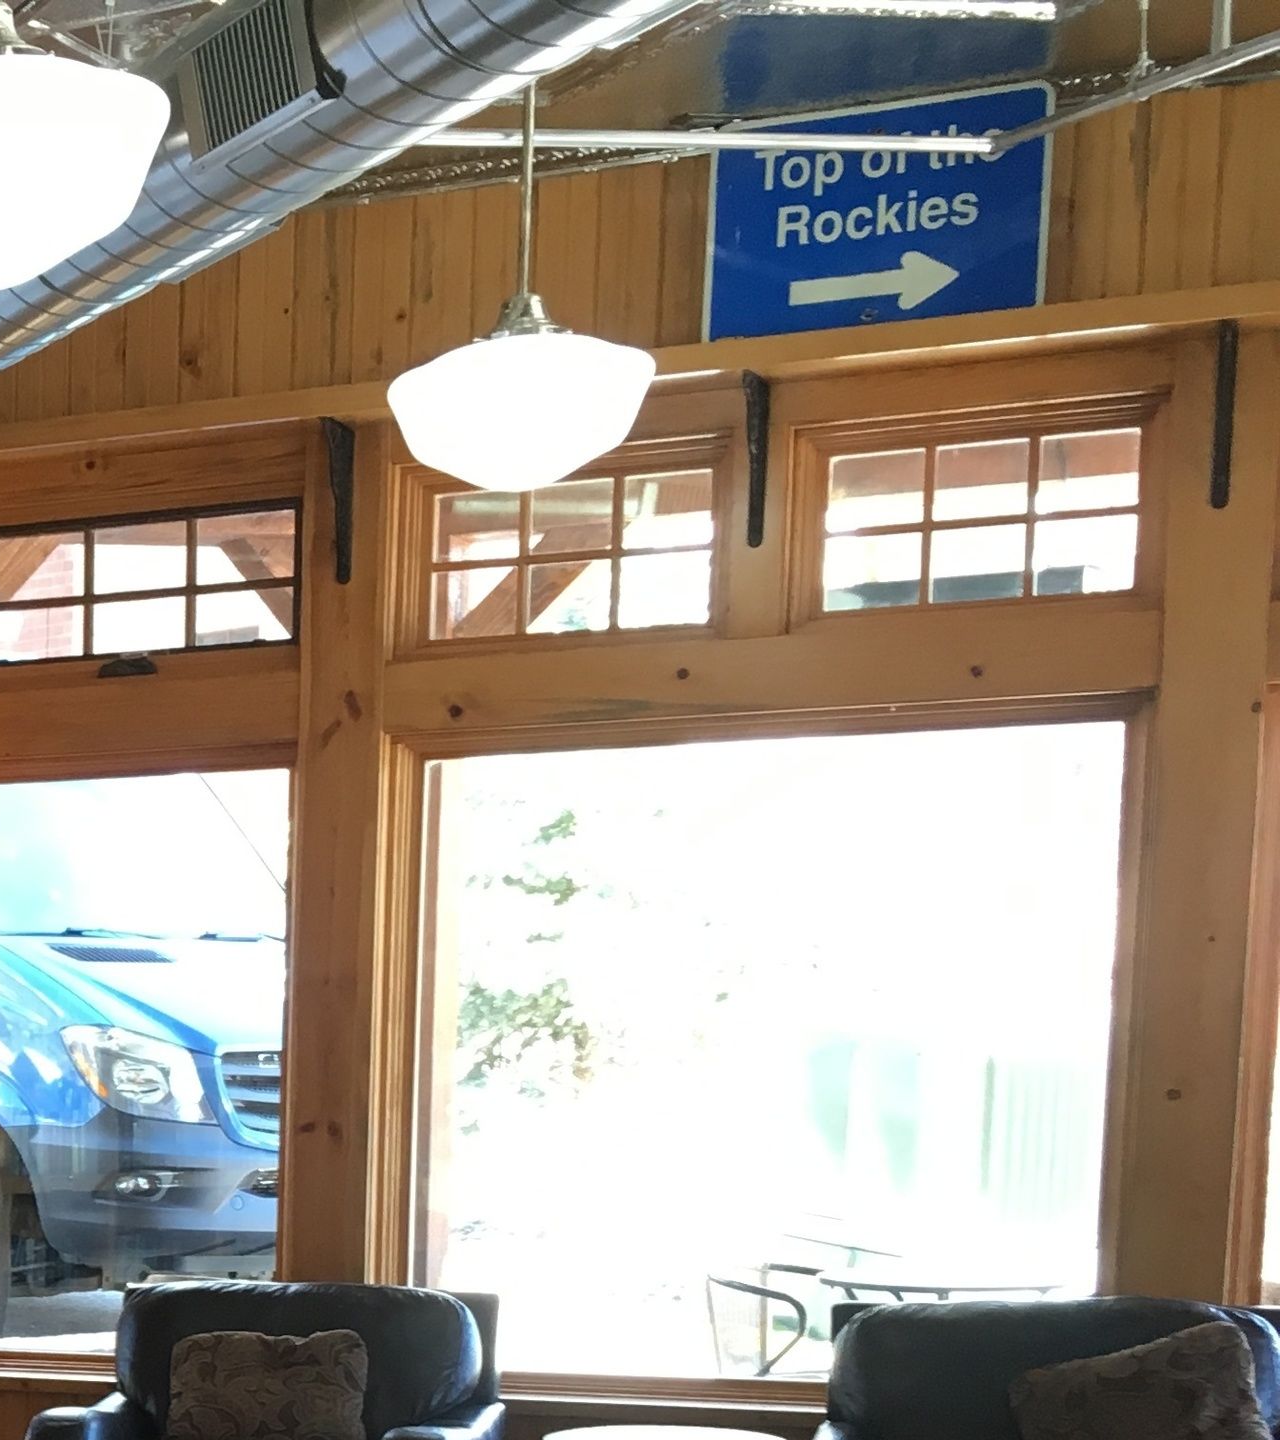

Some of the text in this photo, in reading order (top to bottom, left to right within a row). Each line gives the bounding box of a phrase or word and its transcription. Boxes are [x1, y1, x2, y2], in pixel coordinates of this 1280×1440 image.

[754, 124, 1006, 197] Top of the
[776, 190, 980, 248] Rockies
